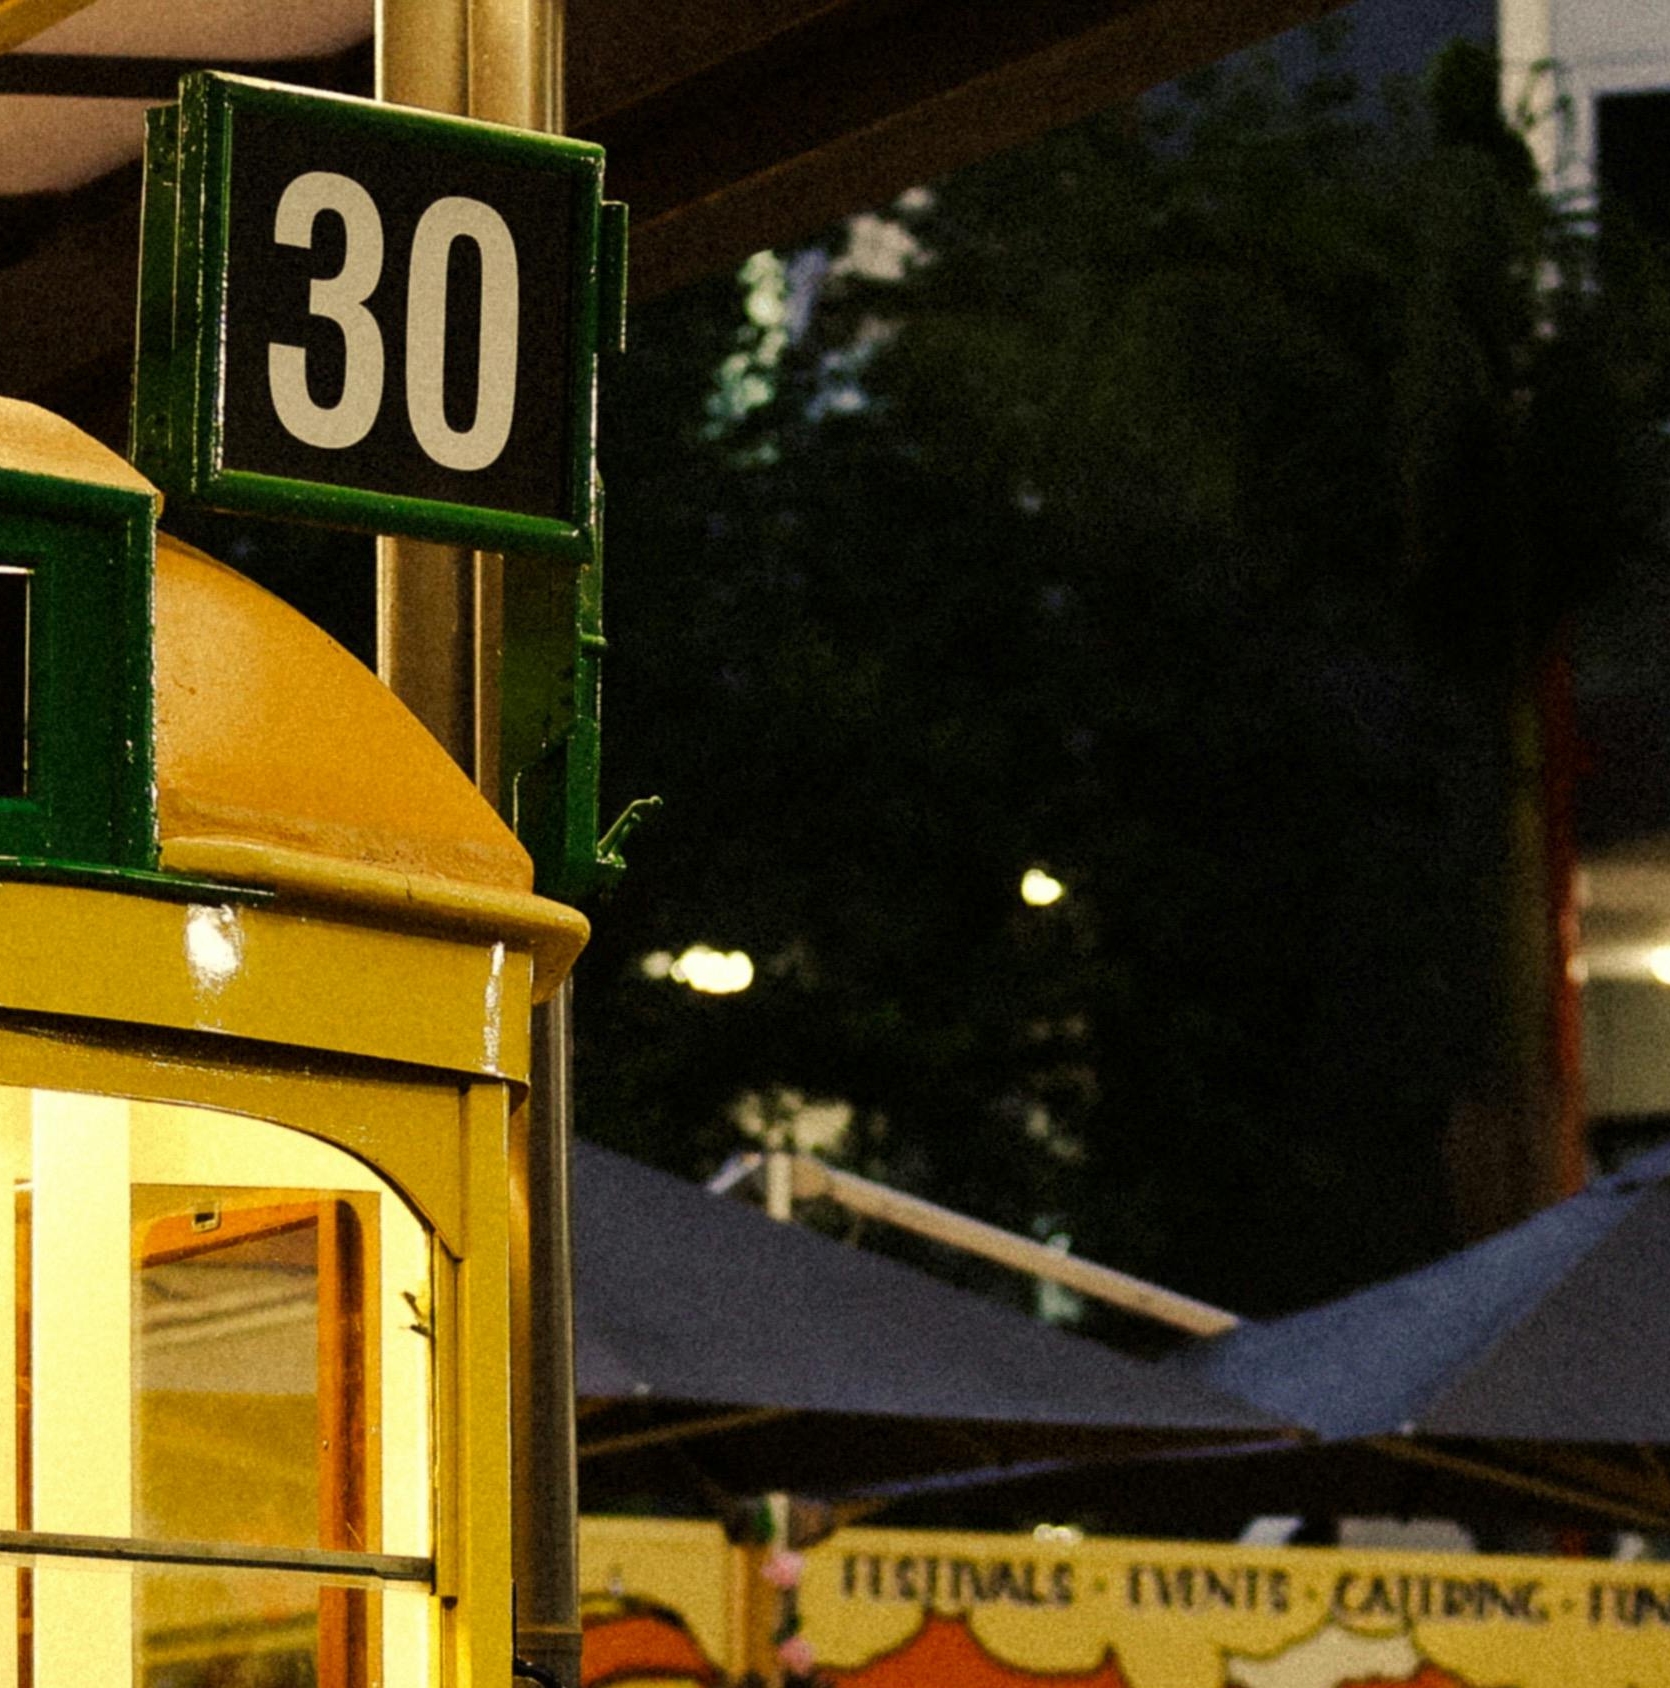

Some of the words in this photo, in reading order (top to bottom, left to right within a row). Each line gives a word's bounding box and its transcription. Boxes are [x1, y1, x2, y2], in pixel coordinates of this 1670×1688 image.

[267, 170, 521, 473] 30
[842, 1554, 1074, 1608] FESTIVALS
[1128, 1564, 1290, 1614] EVENTS
[1332, 1570, 1549, 1623] CATERING
